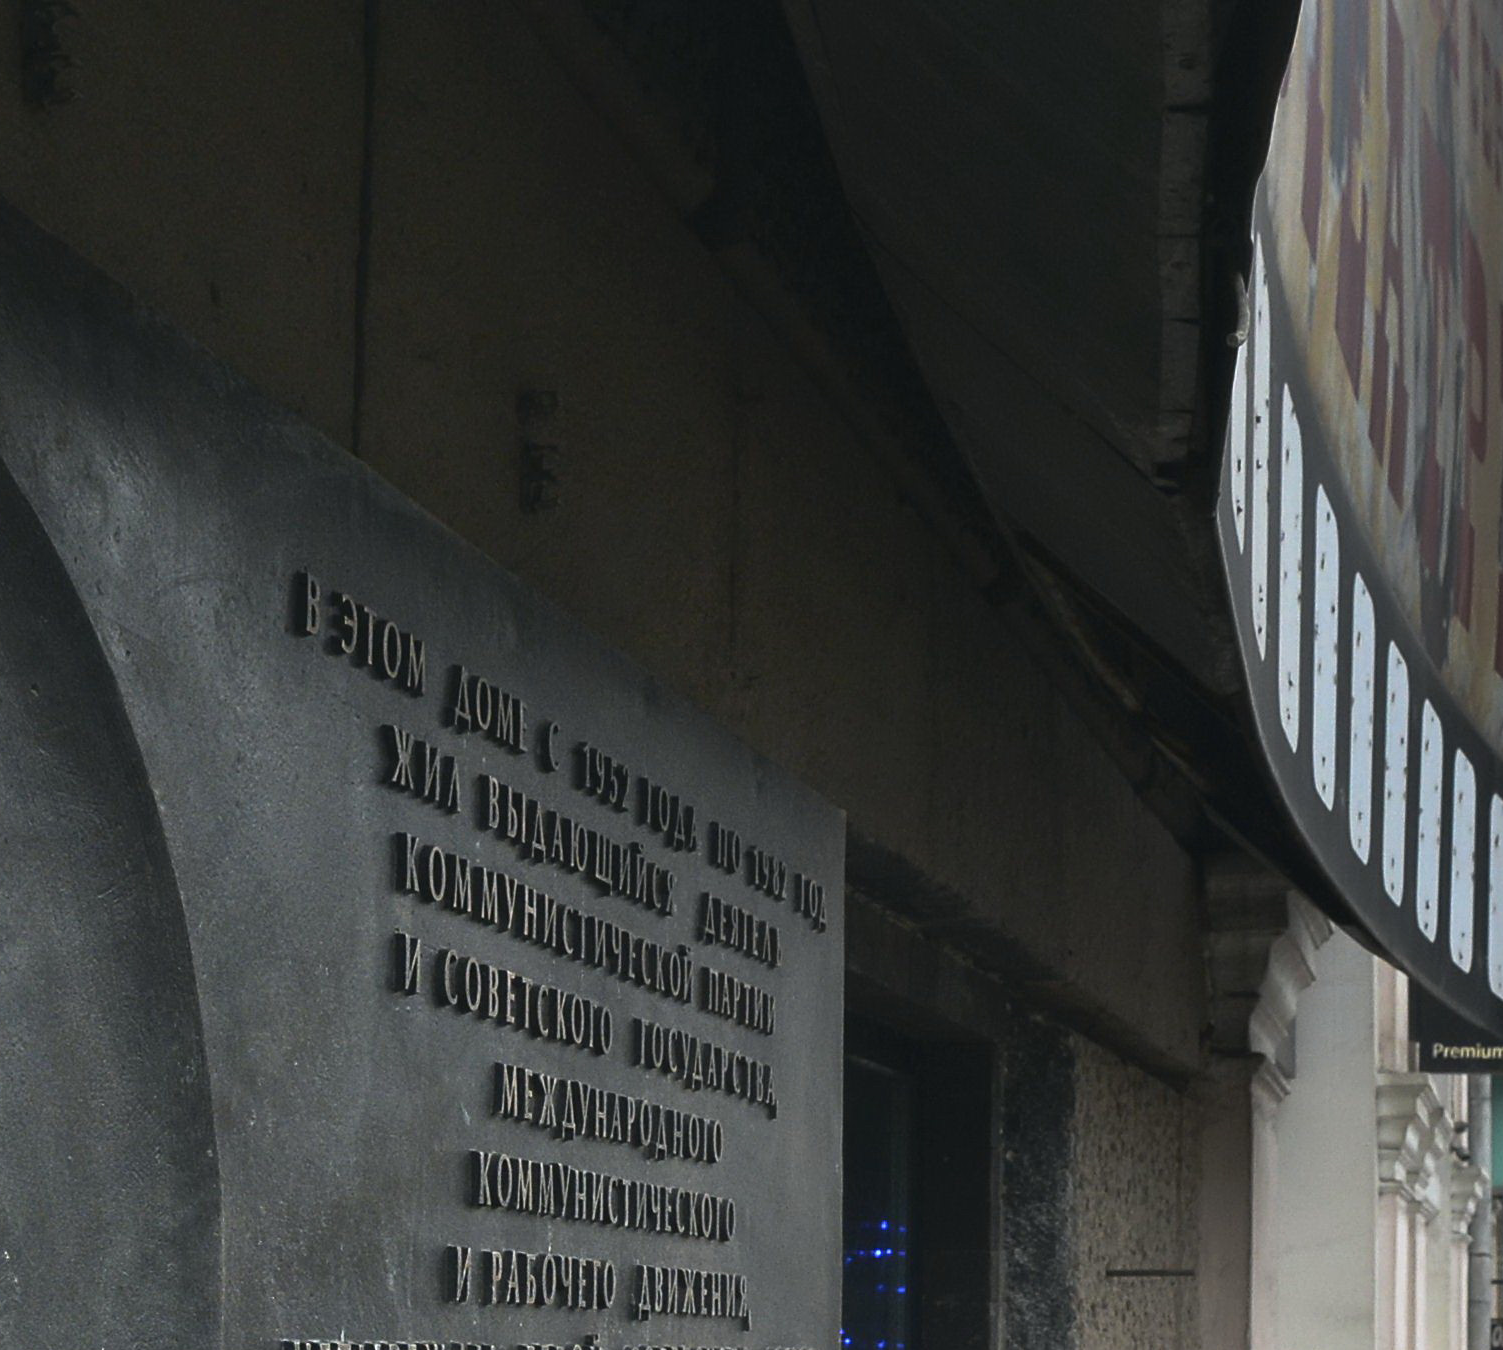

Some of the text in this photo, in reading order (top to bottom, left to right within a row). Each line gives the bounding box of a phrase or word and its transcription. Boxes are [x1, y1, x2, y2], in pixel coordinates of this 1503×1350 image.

[300, 566, 827, 932] В ЭТОМ ДОМЕ С 1952 ГОДА ПО 1982 ГОД
[386, 725, 783, 967] ЖИЛ ВЫДАЮЩИЙСЯ ДЕЯТЕЛЬ
[400, 832, 776, 1035] КОММУНИСТИЧЕСКОЙ ПАРТИИ
[401, 930, 421, 994] И
[441, 948, 613, 1055] СОВЕТСКОГО
[497, 1062, 724, 1164] МЕЖДУНАРОДНОГО
[473, 1151, 737, 1241] КОММУНИСТИЧЕСКОГО
[453, 1246, 752, 1331] И РАБОЧЕГО ДВИЖЕНИЯ,
